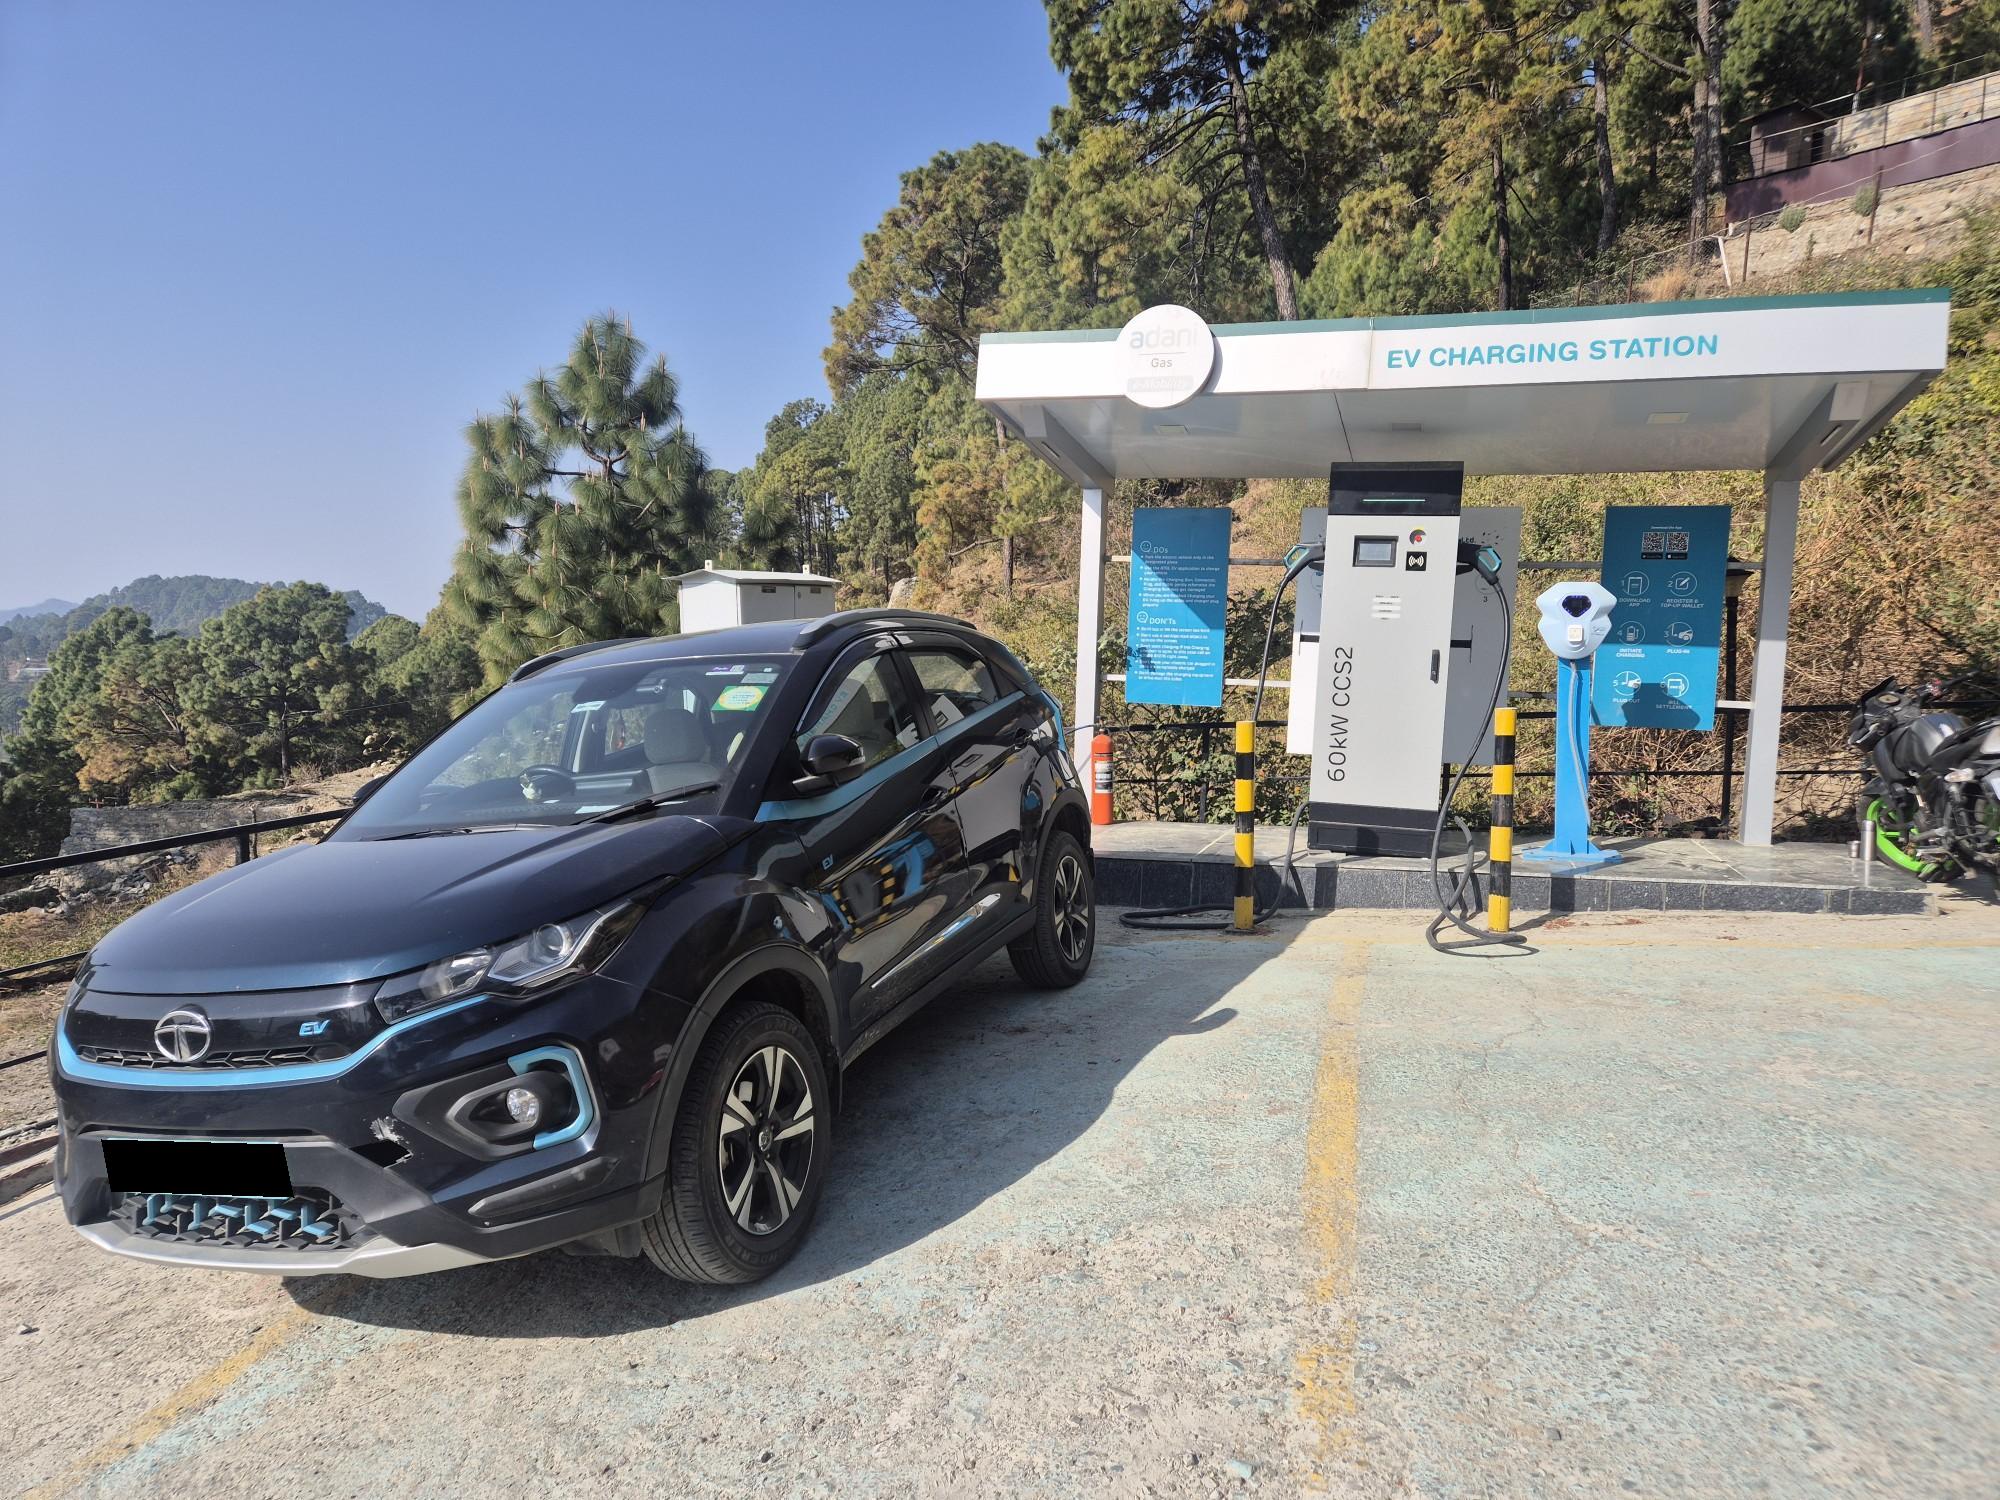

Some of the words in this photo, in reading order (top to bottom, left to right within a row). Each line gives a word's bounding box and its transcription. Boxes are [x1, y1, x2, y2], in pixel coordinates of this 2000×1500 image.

[1129, 322, 1198, 349] adani
[1151, 358, 1173, 368] Gas
[1387, 348, 1421, 369] EV
[1429, 341, 1578, 368] CHARGING
[1589, 334, 1718, 361] STATION
[1332, 647, 1353, 706] CCS2
[1327, 714, 1349, 782] 60kW
[822, 854, 834, 870] EV
[299, 1019, 330, 1037] EV
